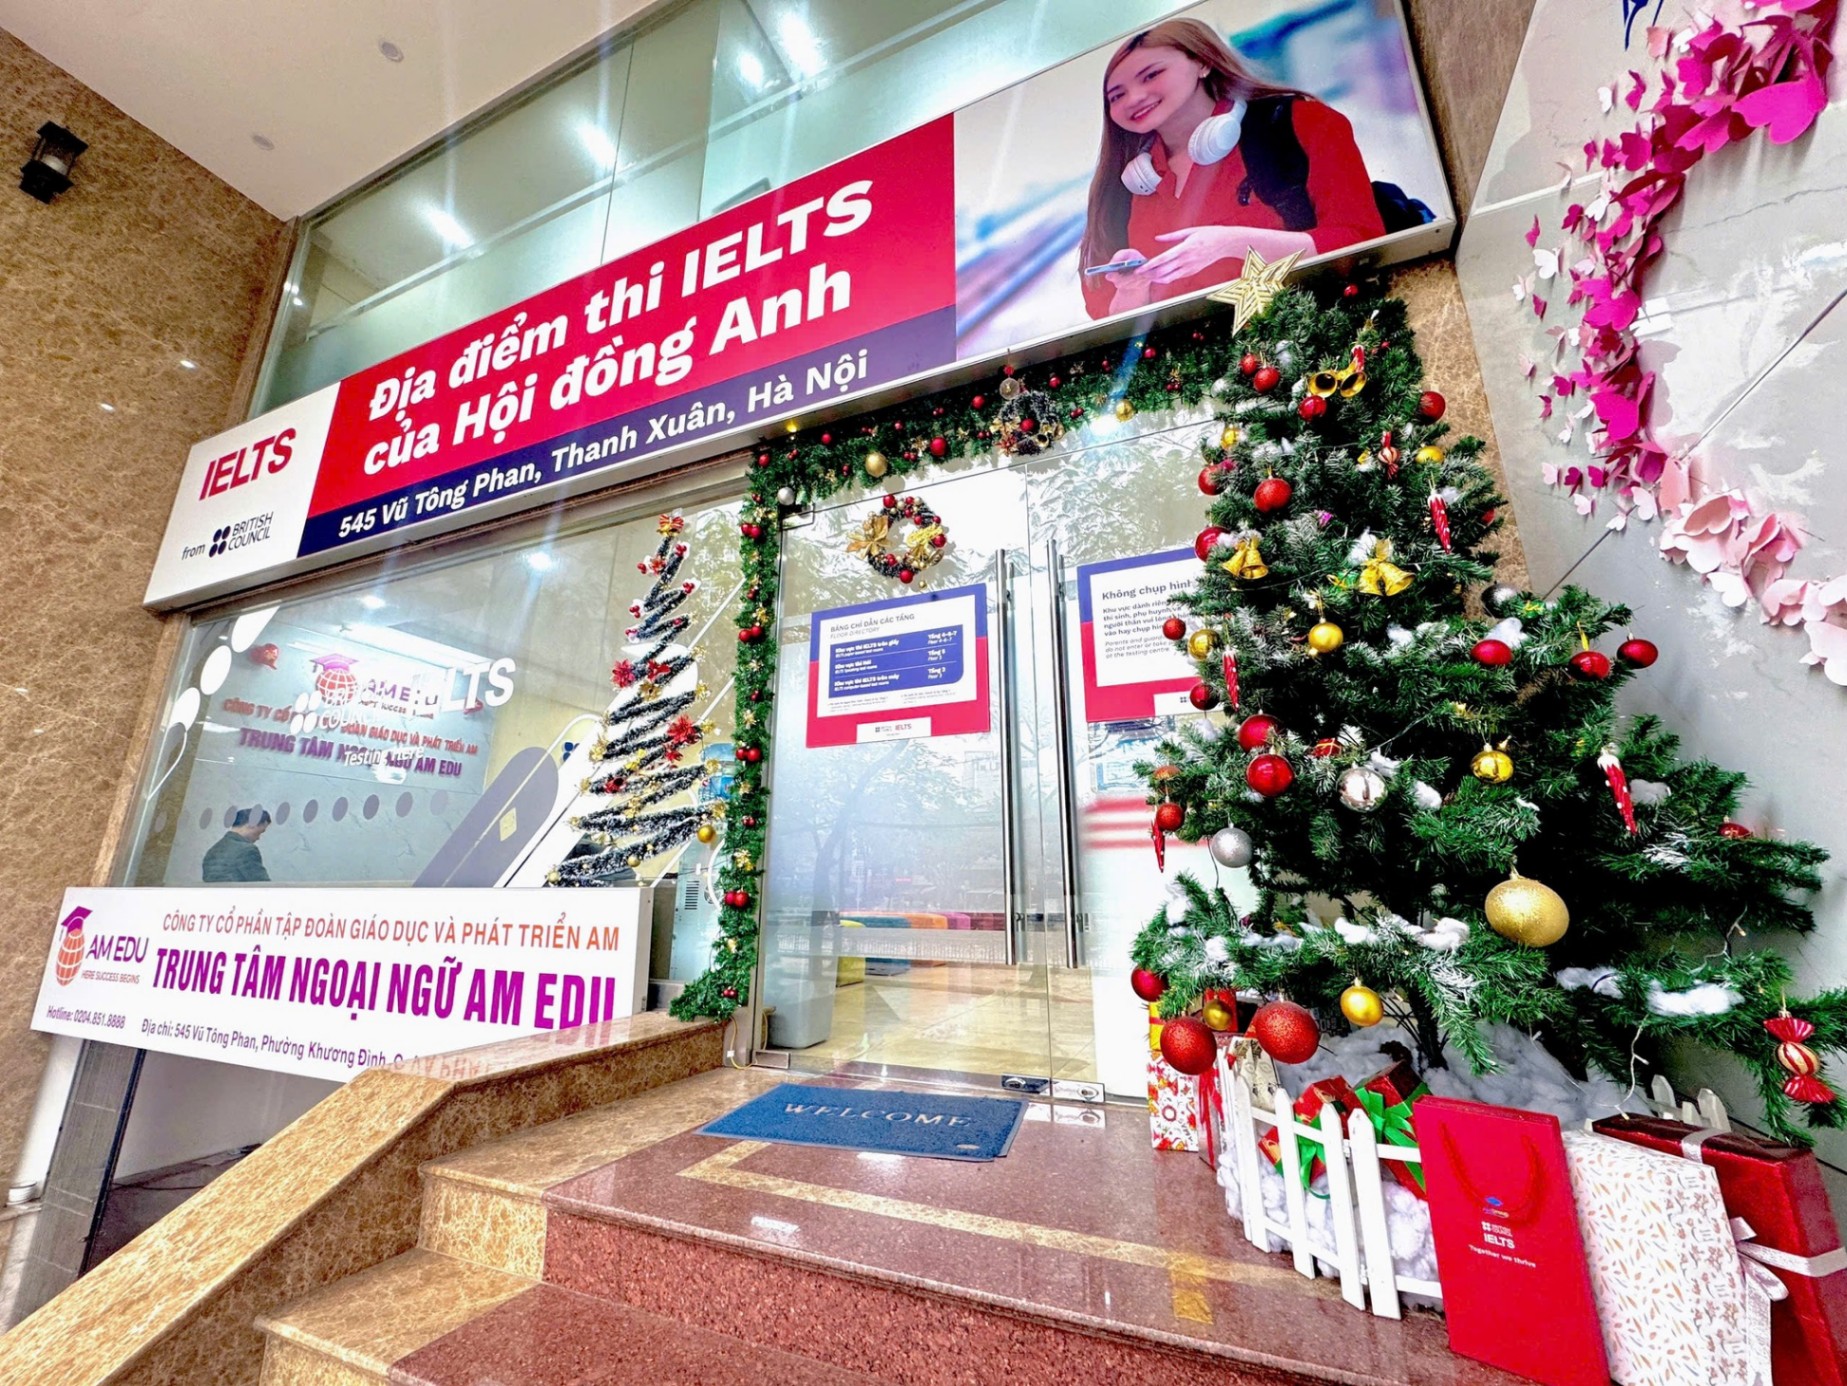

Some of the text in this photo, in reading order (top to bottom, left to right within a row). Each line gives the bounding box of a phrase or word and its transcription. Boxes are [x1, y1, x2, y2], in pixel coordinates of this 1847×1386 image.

[369, 180, 872, 422] Địa điểm thi IELTS
[364, 263, 851, 475] của Hội đồng Anh
[339, 349, 868, 538] 545 Vũ Tông Phan, Thanh Xuân, Hà Nội
[199, 428, 296, 501] IELTS
[232, 511, 274, 537] BRITISH
[181, 543, 206, 560] from
[228, 526, 271, 551] COUNCIL
[1102, 588, 1137, 601] Không
[1138, 584, 1167, 597] chụp
[257, 703, 273, 718] TY
[895, 723, 912, 732] IELTS
[239, 726, 296, 752] TRUNG
[299, 735, 335, 760] TÂM
[438, 759, 462, 778] EDU
[162, 905, 620, 951] CÔNG TY CỔ PHẦN TẬP ĐOÀN GIÁO DỤC VÀ PHÁT TRIỂN AM
[85, 934, 150, 964] AM EDU
[95, 971, 119, 984] SUCCESS
[119, 972, 141, 986] BEGINS
[152, 948, 227, 996] TRUNG
[230, 944, 286, 1000] TÂM
[288, 956, 381, 1021] NGOẠI
[386, 956, 463, 1020] NGỮ
[463, 968, 525, 1027] AM
[46, 1004, 73, 1022] Hotline:
[141, 1018, 156, 1037] Địa
[174, 1022, 191, 1040] 545
[206, 1026, 229, 1048] Tông
[230, 1031, 258, 1051] Phan,
[261, 1034, 305, 1060] Phường
[308, 1041, 355, 1068] Khương
[783, 1103, 972, 1127] WELCOME
[1484, 1233, 1516, 1249] IELTS
